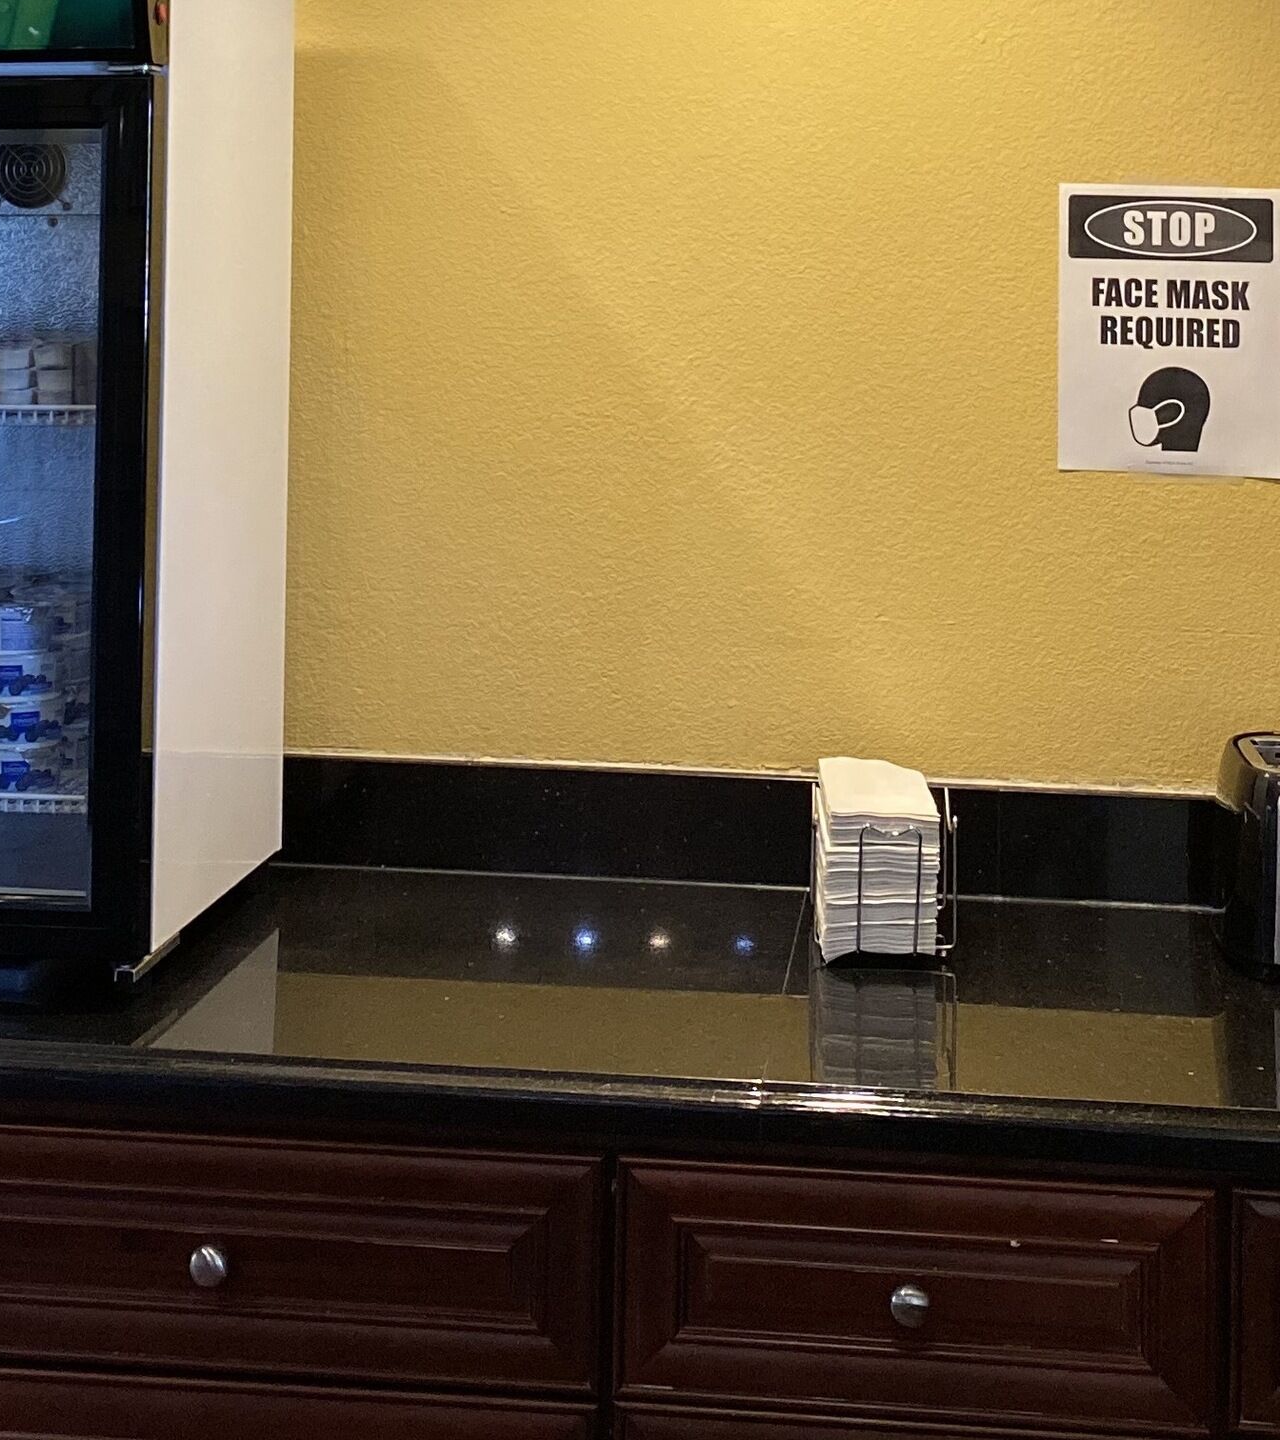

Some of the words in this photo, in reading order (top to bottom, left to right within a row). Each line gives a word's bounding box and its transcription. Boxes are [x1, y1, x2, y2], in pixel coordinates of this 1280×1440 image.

[1122, 209, 1217, 248] STOP
[1091, 277, 1159, 309] FACE
[1165, 279, 1251, 311] MASK
[1099, 314, 1242, 350] REQUIRED
